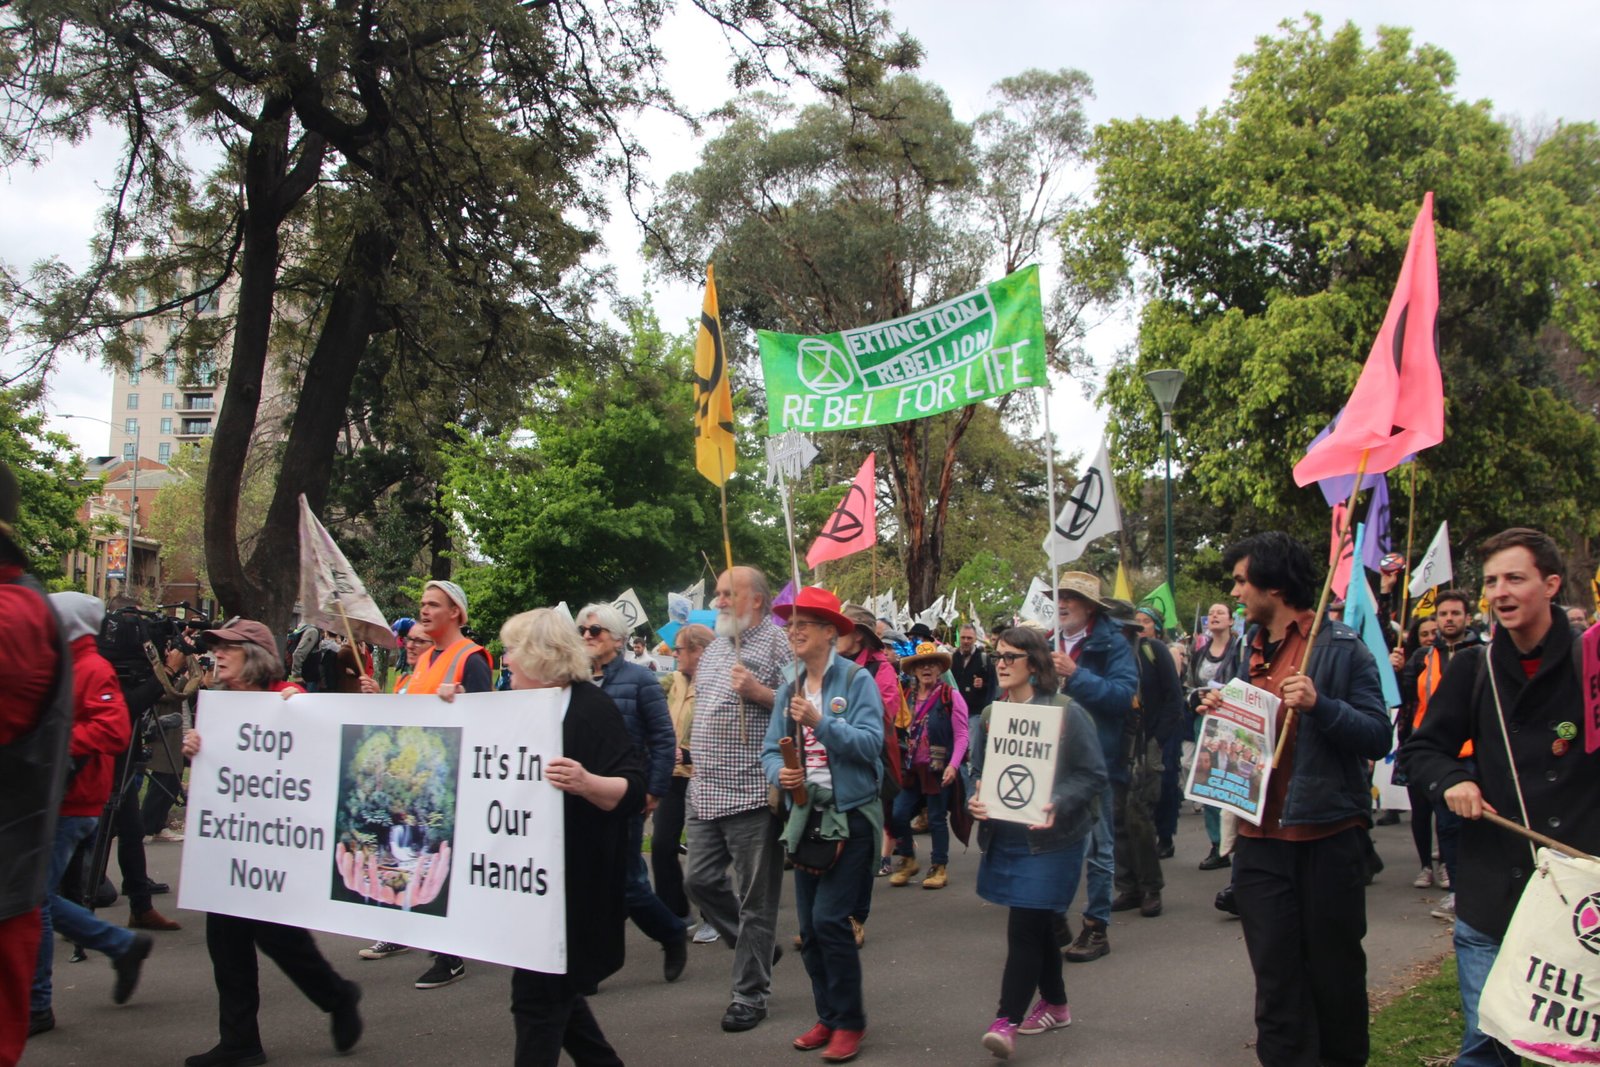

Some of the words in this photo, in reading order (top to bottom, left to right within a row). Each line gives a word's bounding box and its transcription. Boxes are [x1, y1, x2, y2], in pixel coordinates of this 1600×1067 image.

[853, 298, 980, 356] EXTINCTION
[877, 329, 991, 384] REBELLION
[782, 394, 877, 428] REBEL
[896, 374, 956, 418] FOR
[966, 339, 1033, 398] LIFE
[1245, 687, 1262, 708] left
[237, 722, 293, 760] Stop
[1008, 718, 1041, 737] NON
[472, 745, 509, 780] It's
[517, 746, 543, 781] In
[994, 737, 1052, 760] VIOLENT
[216, 766, 312, 802] Species
[198, 809, 325, 851] Extinction
[487, 800, 533, 837] Our
[230, 857, 287, 893] Now
[469, 852, 548, 896] Hands
[1526, 956, 1584, 1001] TELL
